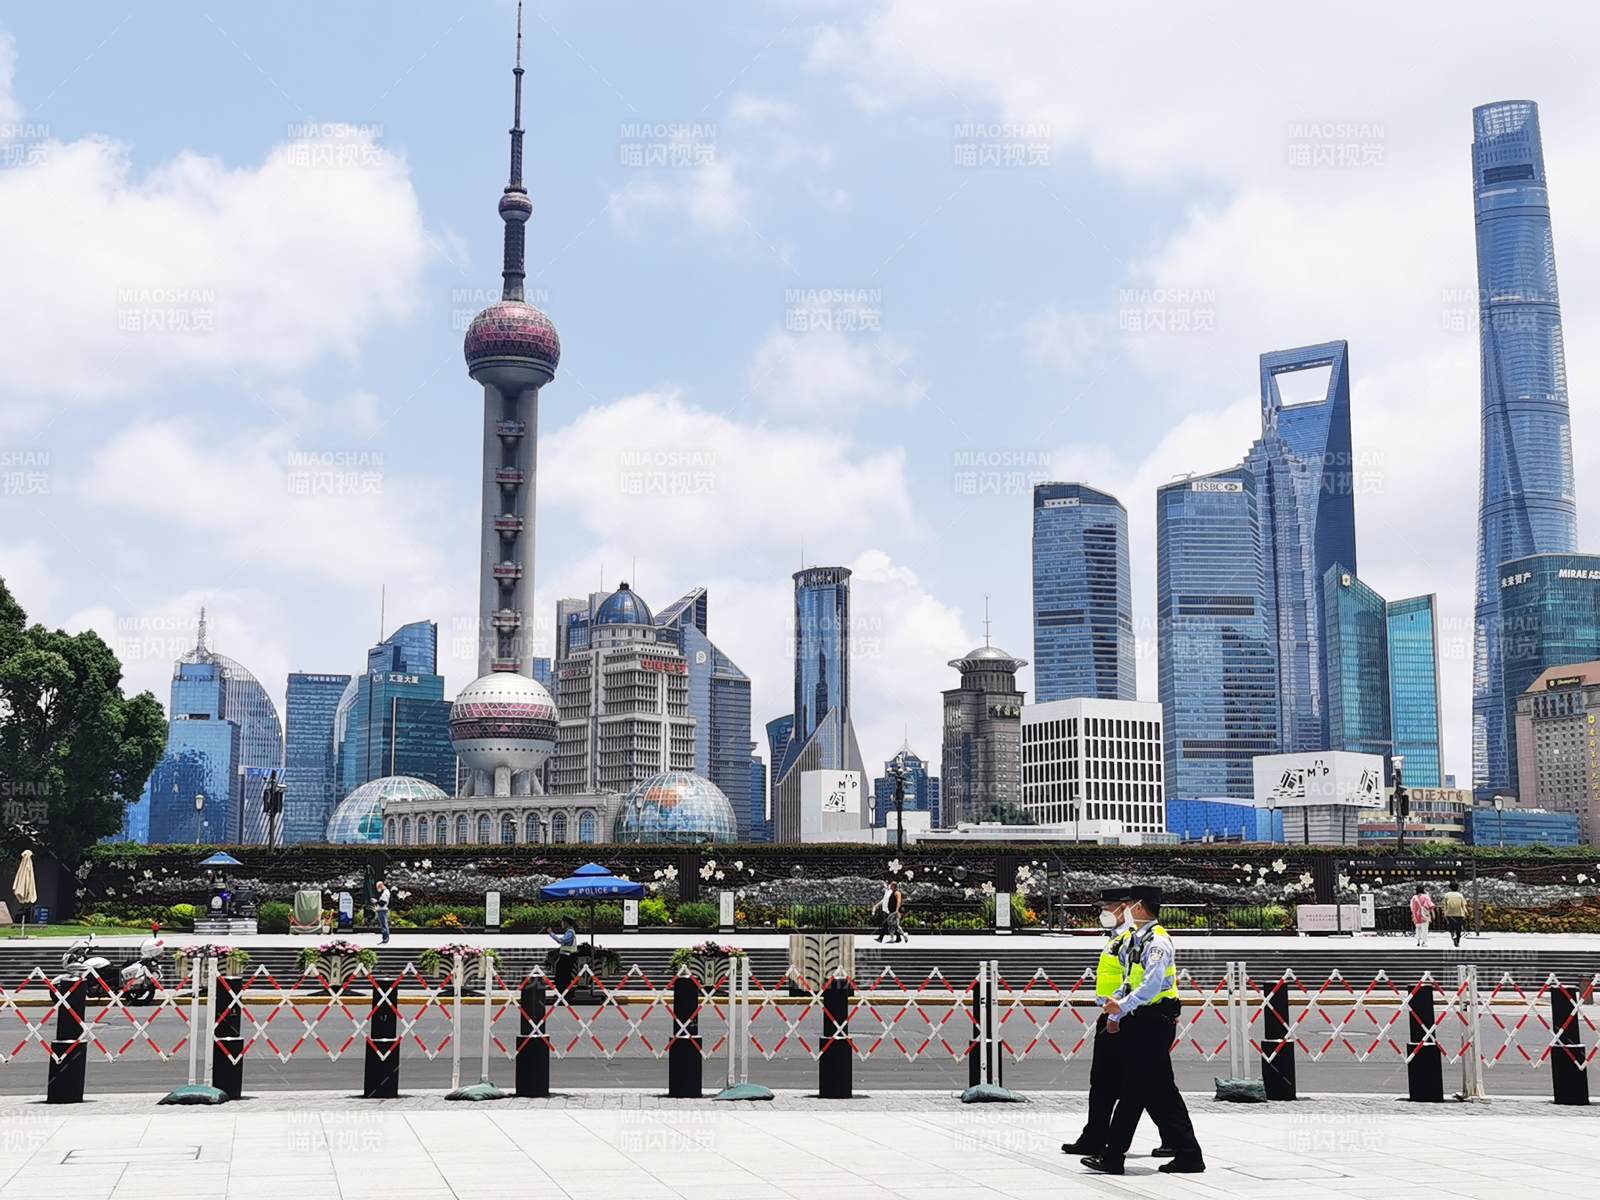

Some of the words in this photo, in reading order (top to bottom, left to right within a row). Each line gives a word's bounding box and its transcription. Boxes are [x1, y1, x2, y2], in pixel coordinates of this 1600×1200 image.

[1195, 482, 1225, 491] HSBC
[1559, 568, 1588, 579] MIRAE
[579, 887, 608, 896] POLICE
